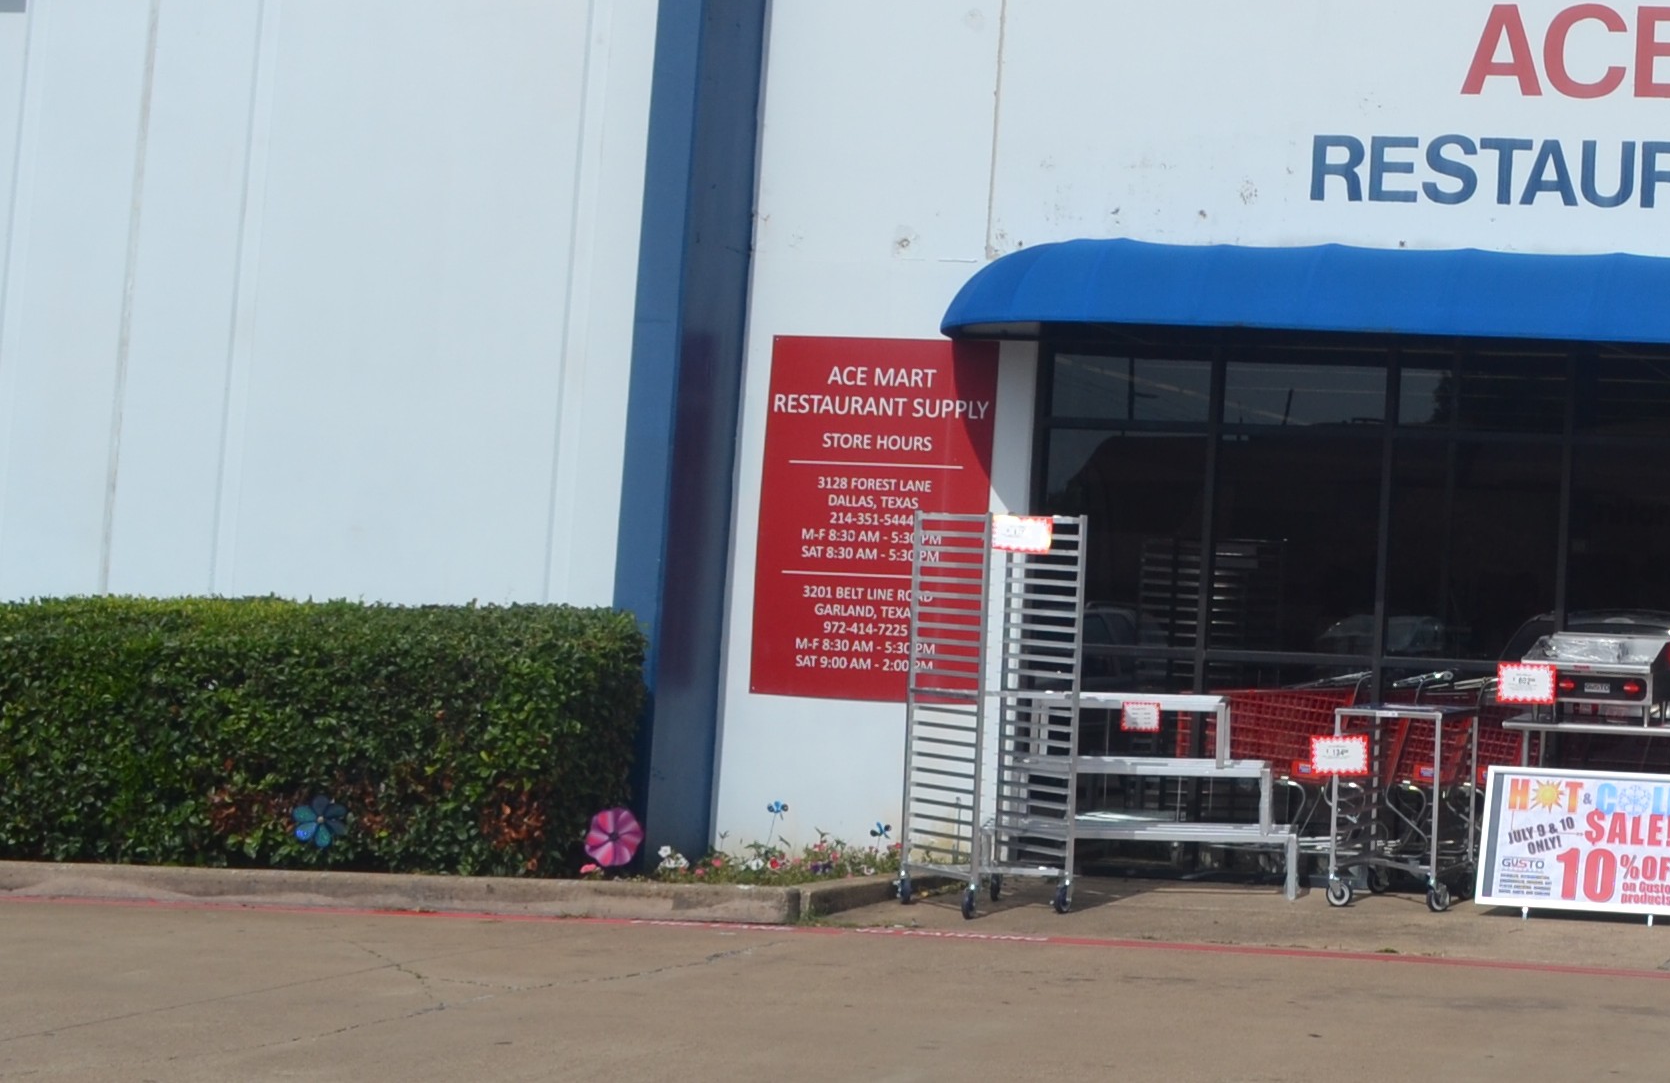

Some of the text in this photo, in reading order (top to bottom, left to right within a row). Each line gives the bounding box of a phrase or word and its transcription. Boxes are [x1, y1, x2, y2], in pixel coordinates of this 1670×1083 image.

[827, 366, 937, 388] ACE MART
[774, 393, 989, 420] RESTAURANT SUPPLY
[822, 433, 932, 452] STORE HOURS
[817, 476, 932, 493] 3128 FOREST LANE
[828, 494, 919, 510] DALLAS, TEXAS
[829, 512, 914, 526] 214-351-5444
[801, 528, 826, 541] M-F
[828, 529, 855, 542] 8:30
[857, 531, 880, 544] AM
[921, 534, 942, 546] PM
[801, 546, 822, 559] SAT
[826, 547, 853, 560] 8:30
[855, 548, 878, 561] AM
[919, 550, 940, 563] PM
[803, 585, 833, 598] 3201
[836, 587, 864, 600] BELT
[867, 588, 894, 601] LINE
[814, 603, 912, 619] GARLAND, TEXA
[823, 621, 908, 637] 972-414-7225
[795, 638, 819, 650] M-F
[822, 639, 849, 652] 8:30
[852, 640, 874, 653] AM
[915, 643, 936, 656] PM
[795, 655, 816, 668] SAT
[820, 655, 848, 669] 9:00
[849, 657, 871, 670] AM
[882, 658, 909, 672] 2:00
[1583, 793, 1592, 805] &
[1508, 816, 1575, 845] JULY 9 & 10
[1527, 835, 1562, 856] ONLY!
[1502, 858, 1545, 869] GUSTO
[1622, 882, 1637, 892] on
